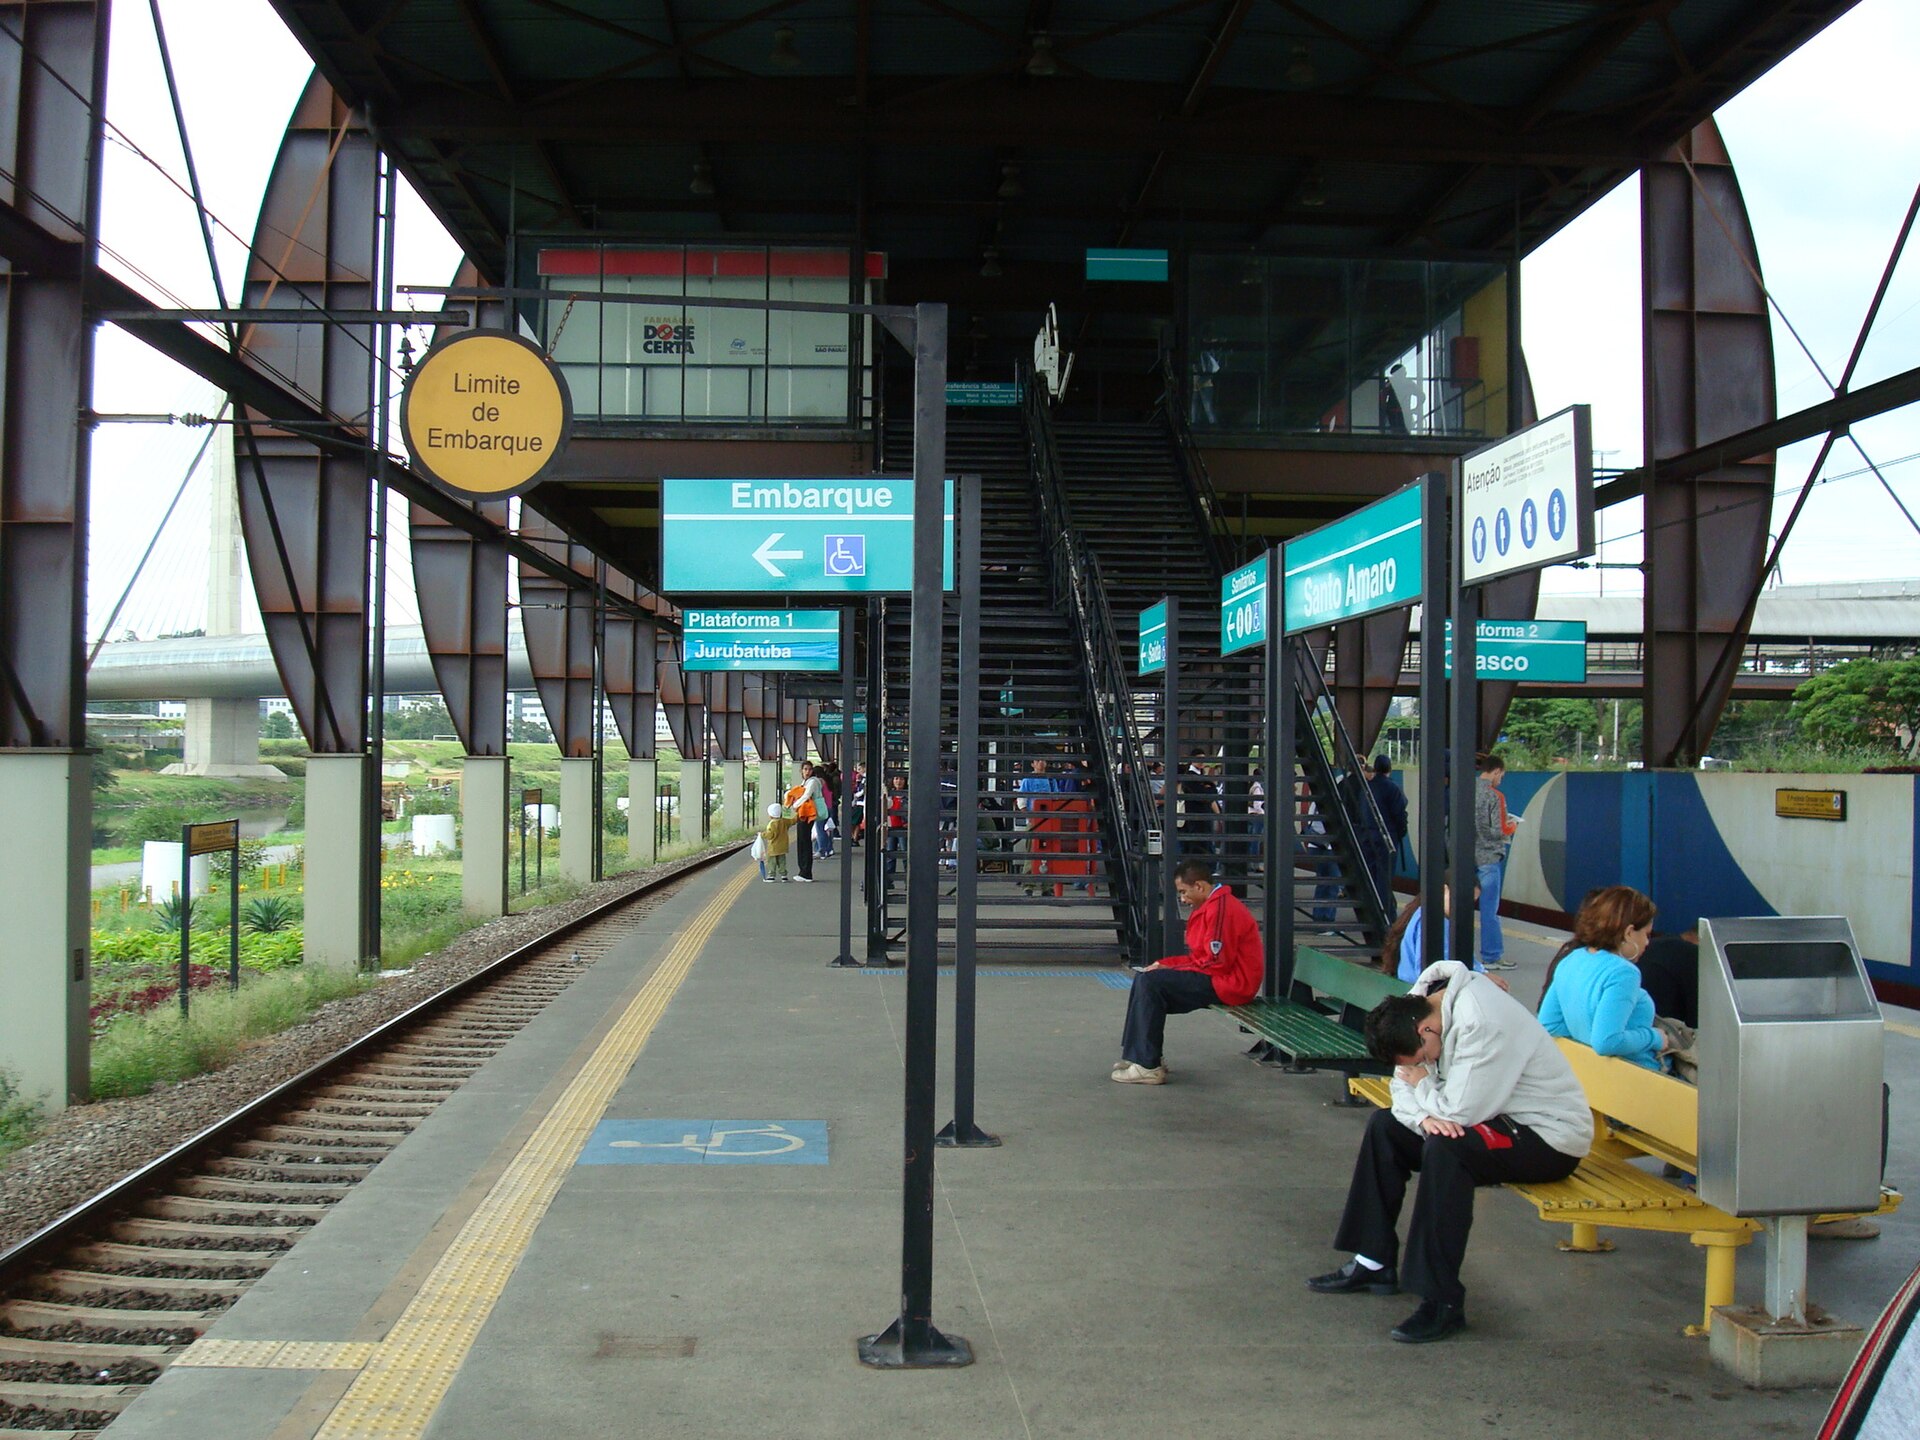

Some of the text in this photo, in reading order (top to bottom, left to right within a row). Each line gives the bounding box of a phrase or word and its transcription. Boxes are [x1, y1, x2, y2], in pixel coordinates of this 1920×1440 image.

[644, 324, 695, 340] DOSE
[643, 340, 695, 354] CERTA
[454, 373, 520, 395] Limite
[472, 402, 500, 422] de
[428, 428, 543, 456] Embarque
[1466, 463, 1501, 494] Atenção
[731, 482, 893, 514] Embarque
[1231, 569, 1257, 595] Sanitários
[1304, 557, 1397, 618] Santo Amaro
[688, 612, 793, 628] Plataforma 1
[1529, 624, 1539, 638] 2
[1147, 640, 1162, 664] Saída
